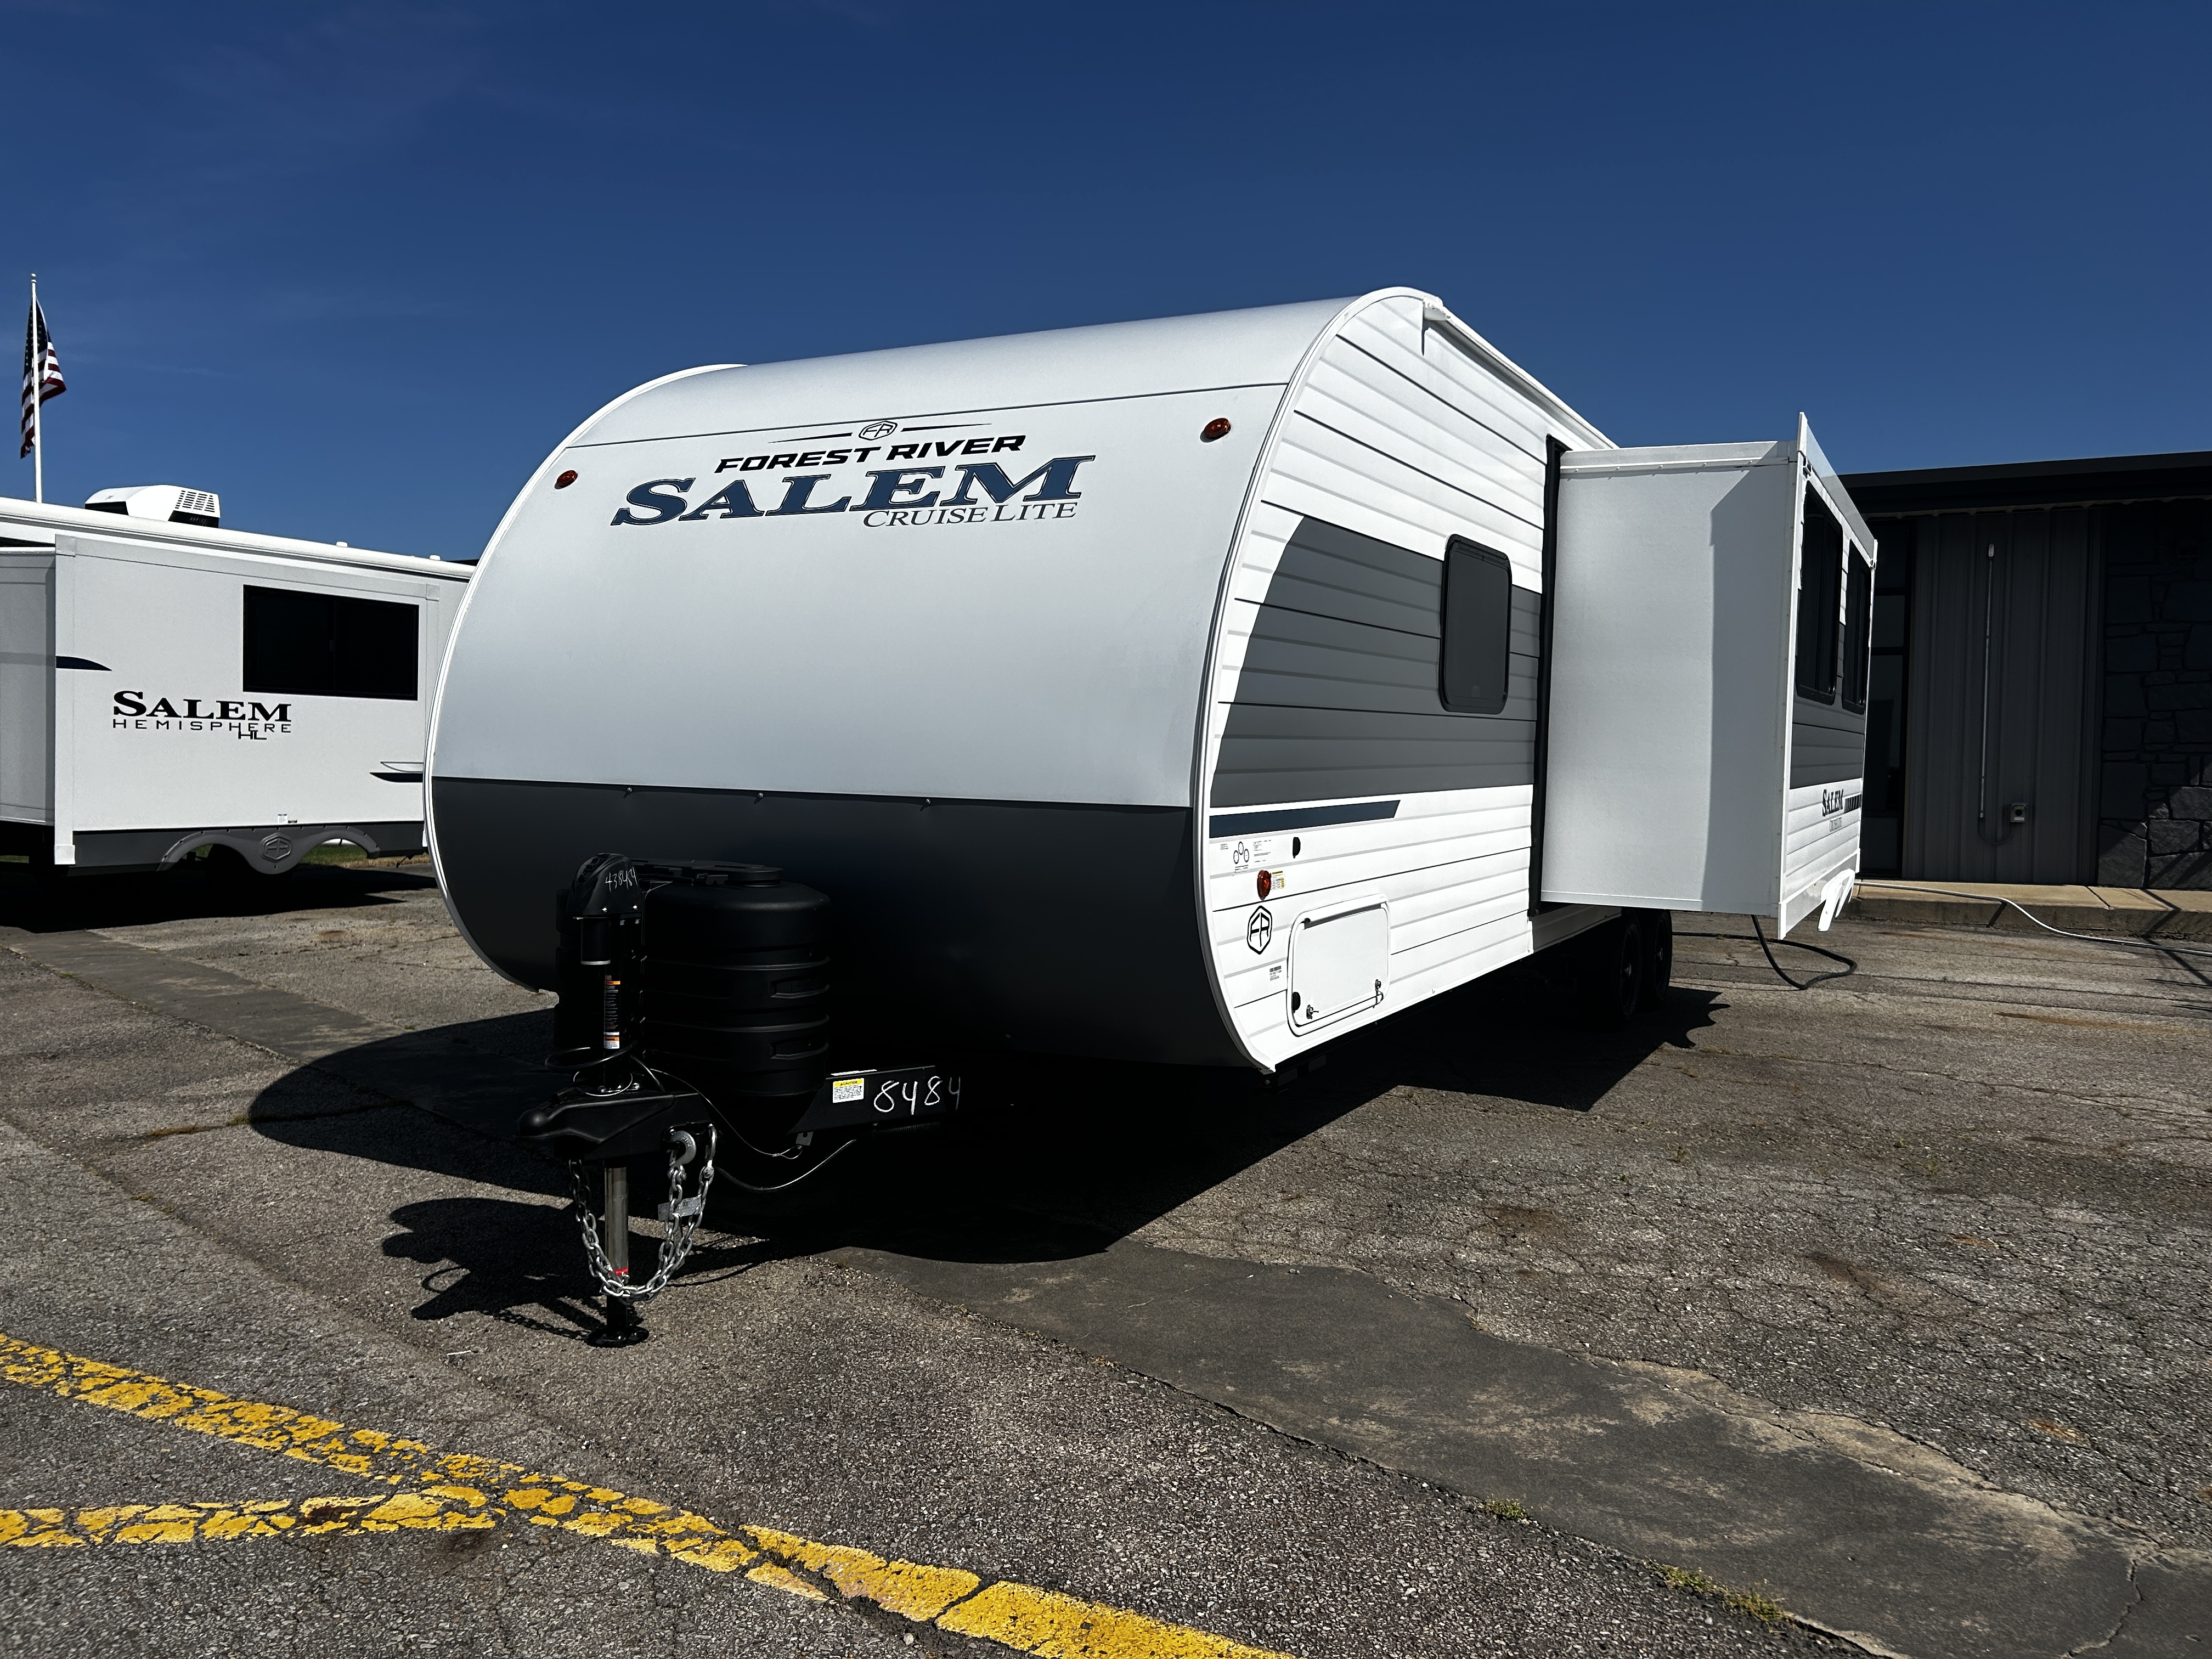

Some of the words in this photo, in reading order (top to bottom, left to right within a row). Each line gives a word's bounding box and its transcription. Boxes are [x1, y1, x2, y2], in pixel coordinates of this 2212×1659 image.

[714, 446, 881, 473] FOREST
[888, 435, 1026, 460] RIVER
[610, 455, 1096, 526] SALEM
[863, 507, 987, 527] CRUISE
[990, 502, 1078, 522] LITE
[113, 690, 292, 722] SALEM
[112, 719, 291, 733] HEMISPHERE
[873, 1075, 961, 1115] 8484
